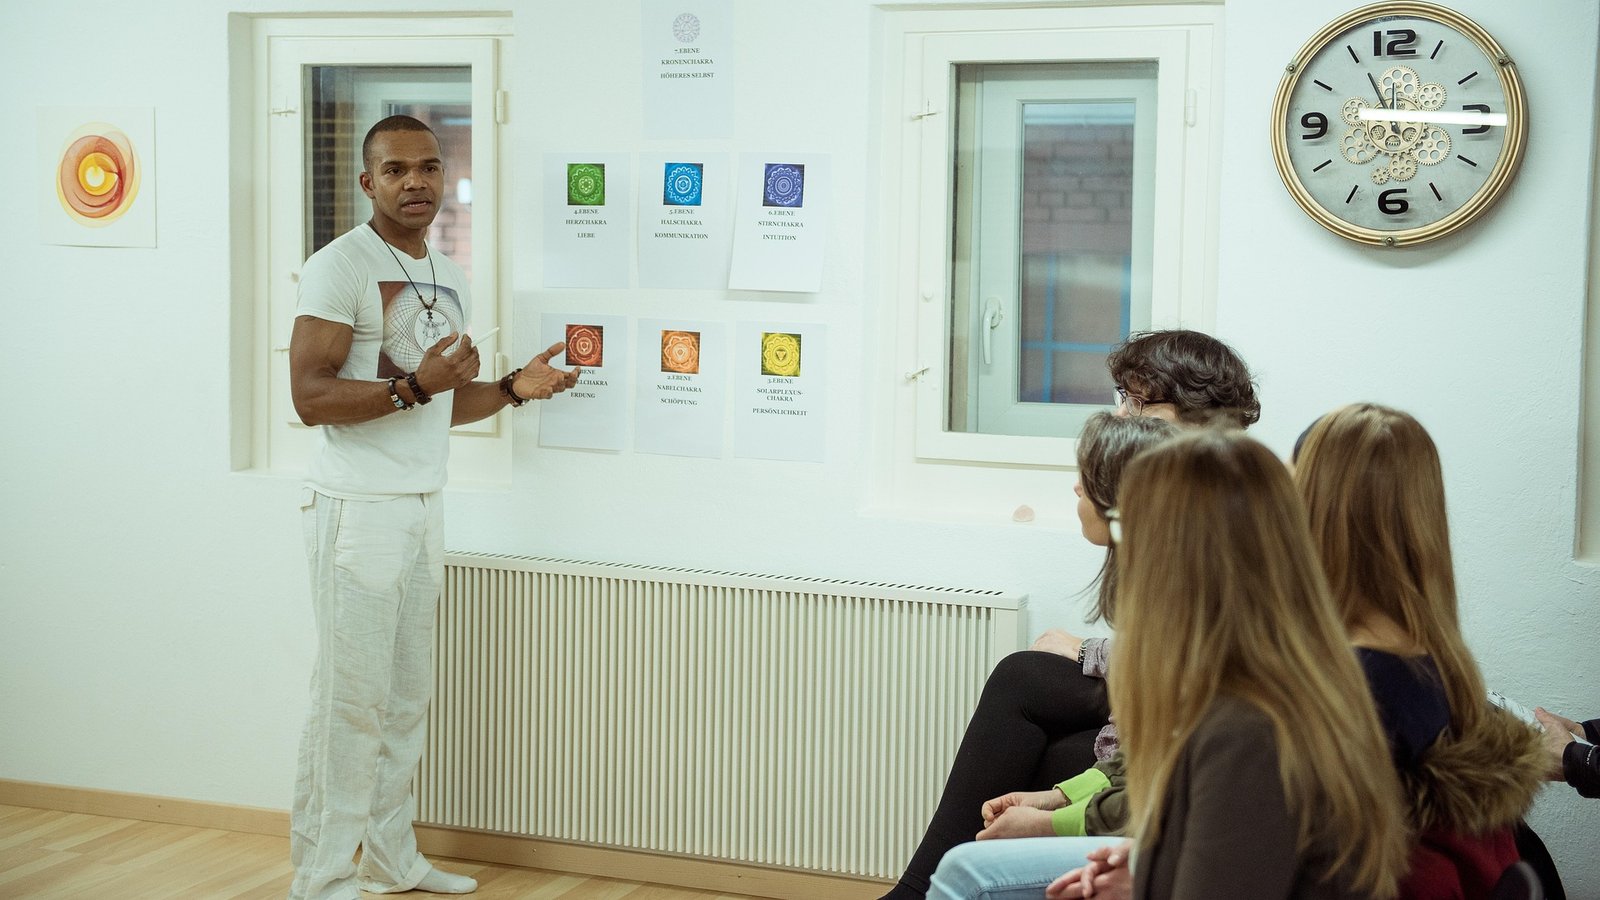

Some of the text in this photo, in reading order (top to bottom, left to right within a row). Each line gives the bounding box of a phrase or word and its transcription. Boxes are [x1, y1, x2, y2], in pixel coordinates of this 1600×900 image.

[1373, 29, 1417, 57] 12
[660, 71, 690, 79] HÖHERES
[1300, 111, 1329, 140] 9
[1377, 188, 1409, 215] 6
[758, 220, 804, 228] STIRNCHAKRA
[657, 384, 702, 393] NABELCHAKRA
[570, 391, 596, 399] ERDUNG
[660, 398, 698, 406] SCHÖPFUNG
[752, 407, 808, 416] PERSÖNLICHKEIT
